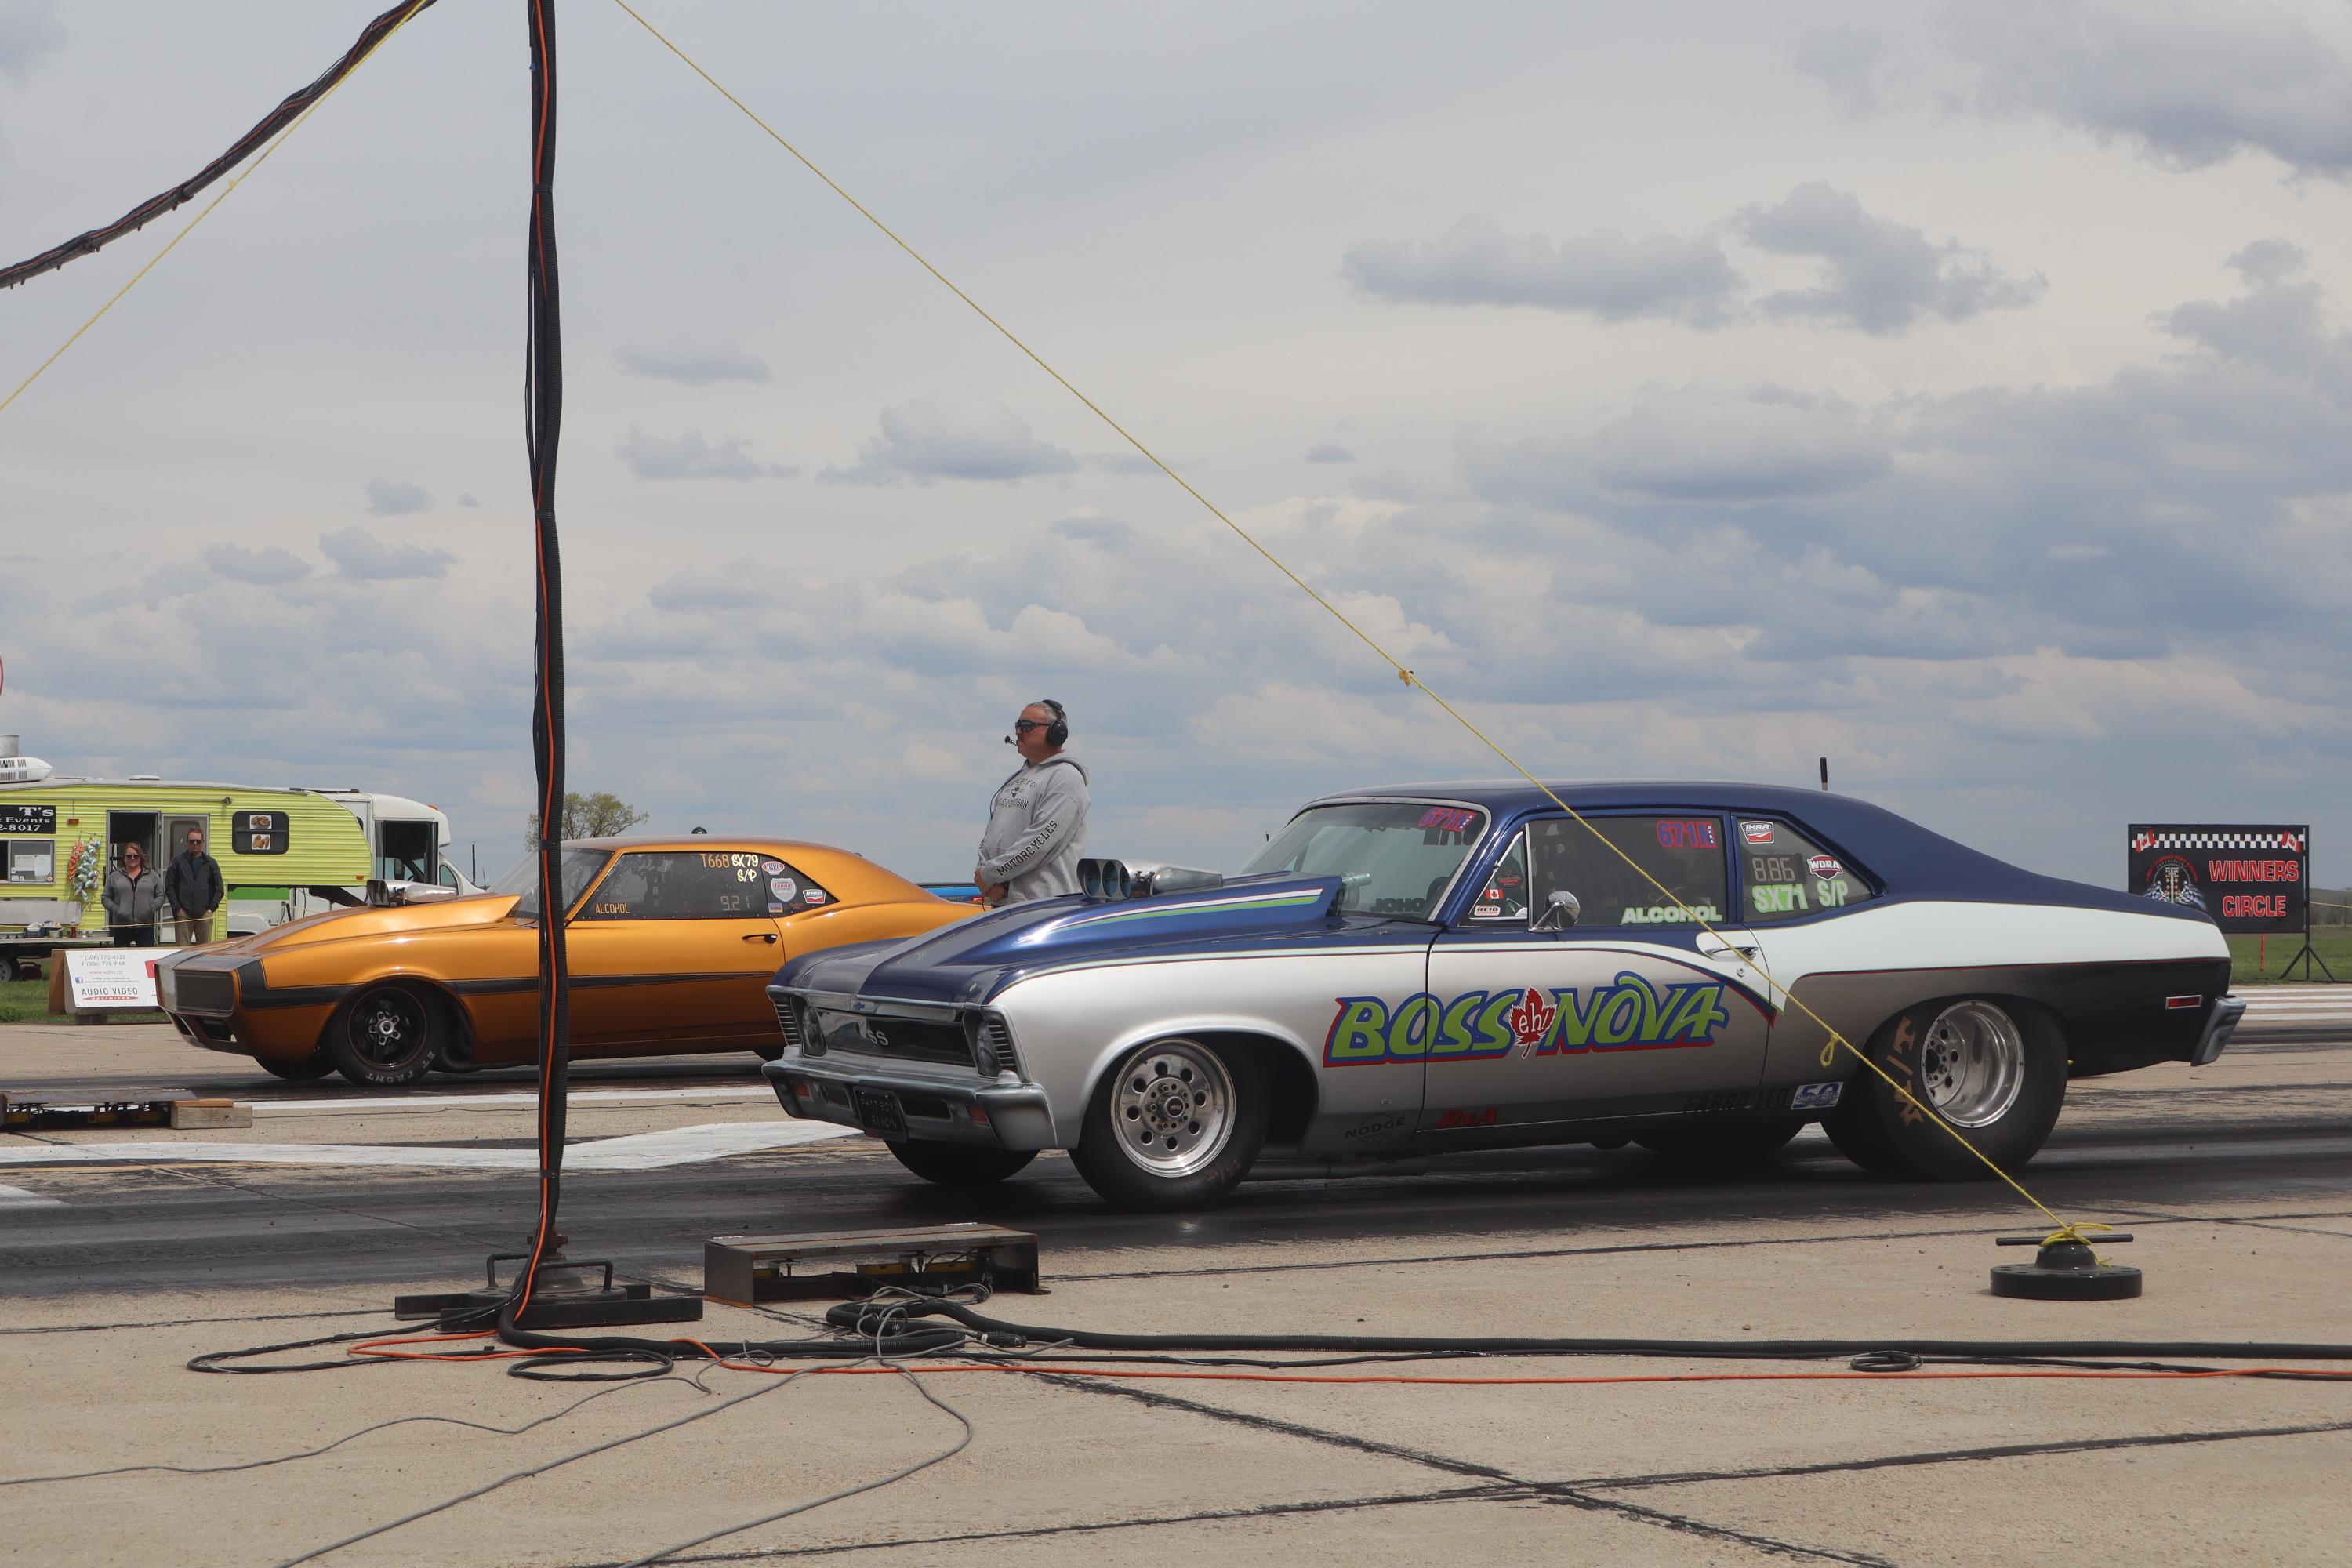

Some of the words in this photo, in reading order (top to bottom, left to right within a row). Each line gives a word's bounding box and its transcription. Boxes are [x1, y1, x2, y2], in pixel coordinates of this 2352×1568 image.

[996, 820, 1058, 876] MOTORCYCLES
[701, 854, 730, 868] T668
[731, 854, 759, 867] SX79
[1752, 858, 1795, 881] 8.86
[1808, 860, 1841, 869] WDRA
[2209, 860, 2299, 882] WINNERS
[737, 869, 757, 882] S/P
[1751, 884, 1809, 913] SX71
[1817, 880, 1848, 907] S/P
[2222, 895, 2286, 917] CIRCLE
[596, 904, 630, 914] ALCOHOL
[1620, 906, 1723, 924] ALCOHOL
[1323, 989, 1524, 1068] BOSS
[1518, 1009, 1550, 1036] eh!
[1537, 972, 1729, 1055] NOVA
[867, 1030, 889, 1046] SS
[1345, 1117, 1406, 1139] NODGE
